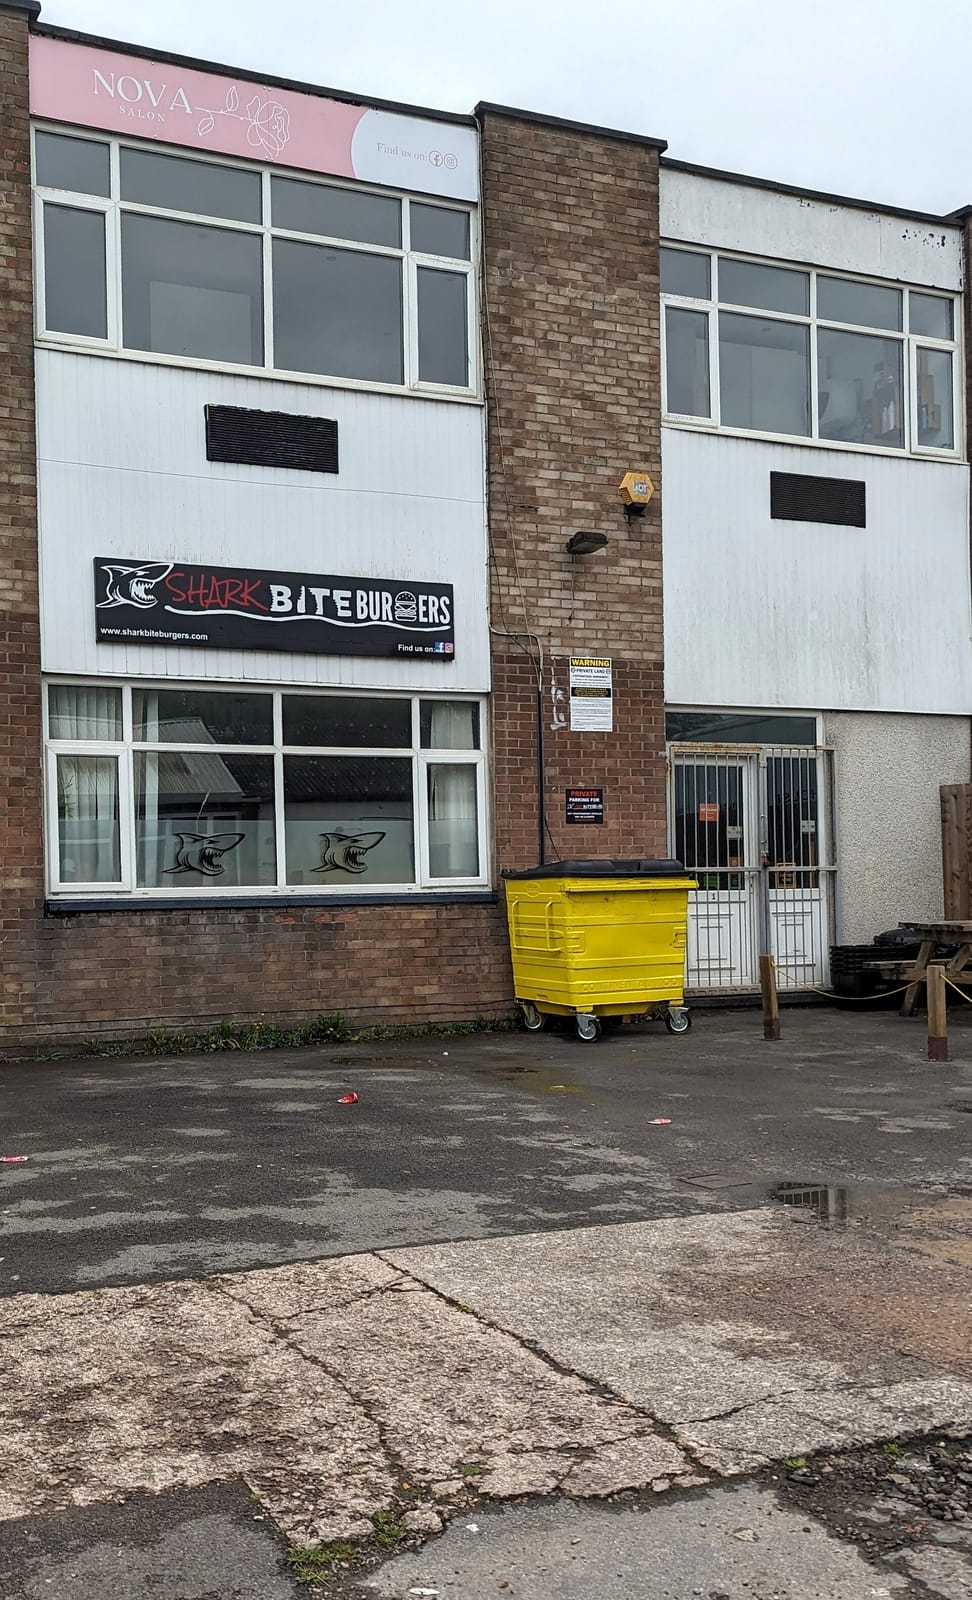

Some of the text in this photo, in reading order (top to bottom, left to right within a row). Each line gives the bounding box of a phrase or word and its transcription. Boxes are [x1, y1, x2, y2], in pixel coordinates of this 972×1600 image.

[92, 68, 193, 114] NOVA
[119, 105, 165, 122] SALON
[376, 142, 399, 155] Find
[164, 573, 451, 624] SHARK BITE BURERS
[100, 626, 208, 640] www.sharkbiteburgers.com
[397, 643, 414, 652] Find
[571, 658, 610, 667] WARNING
[571, 790, 598, 798] PRIVATE
